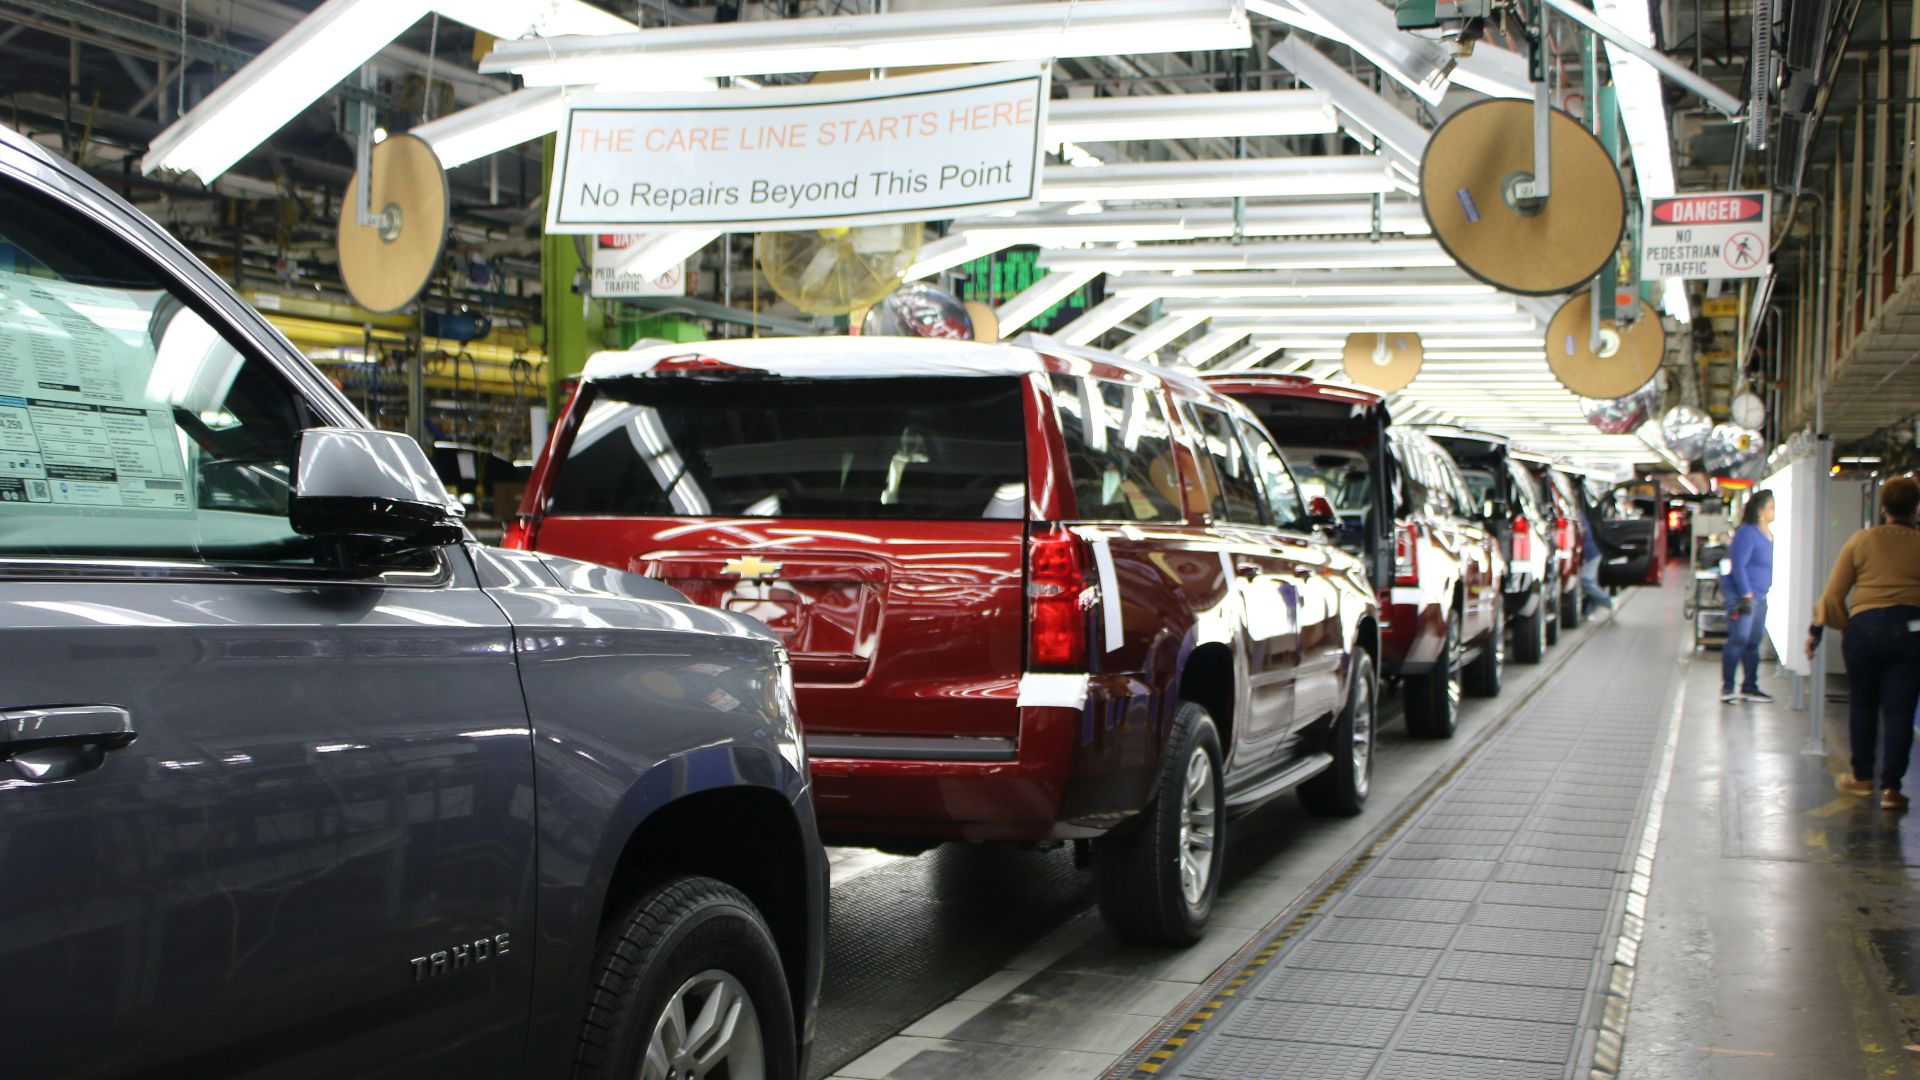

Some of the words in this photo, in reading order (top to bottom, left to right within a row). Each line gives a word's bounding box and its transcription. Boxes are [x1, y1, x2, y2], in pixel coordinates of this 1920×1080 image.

[576, 127, 635, 153] THE
[645, 126, 730, 152] CARE
[740, 123, 808, 150] LINE
[817, 111, 939, 146] STARTS
[948, 98, 1033, 133] HERE
[580, 182, 619, 207] No
[630, 181, 739, 212] Repairs
[750, 174, 858, 209] Beyond
[870, 169, 928, 196] This
[939, 160, 1013, 191] Point
[1671, 199, 1741, 223] DANGER
[1675, 229, 1692, 243] NO
[1646, 244, 1720, 261] PEDESTRIAN
[1658, 262, 1707, 276] TRAFFIC
[604, 281, 640, 293] TRAFFIC
[410, 932, 510, 981] TAHOE
